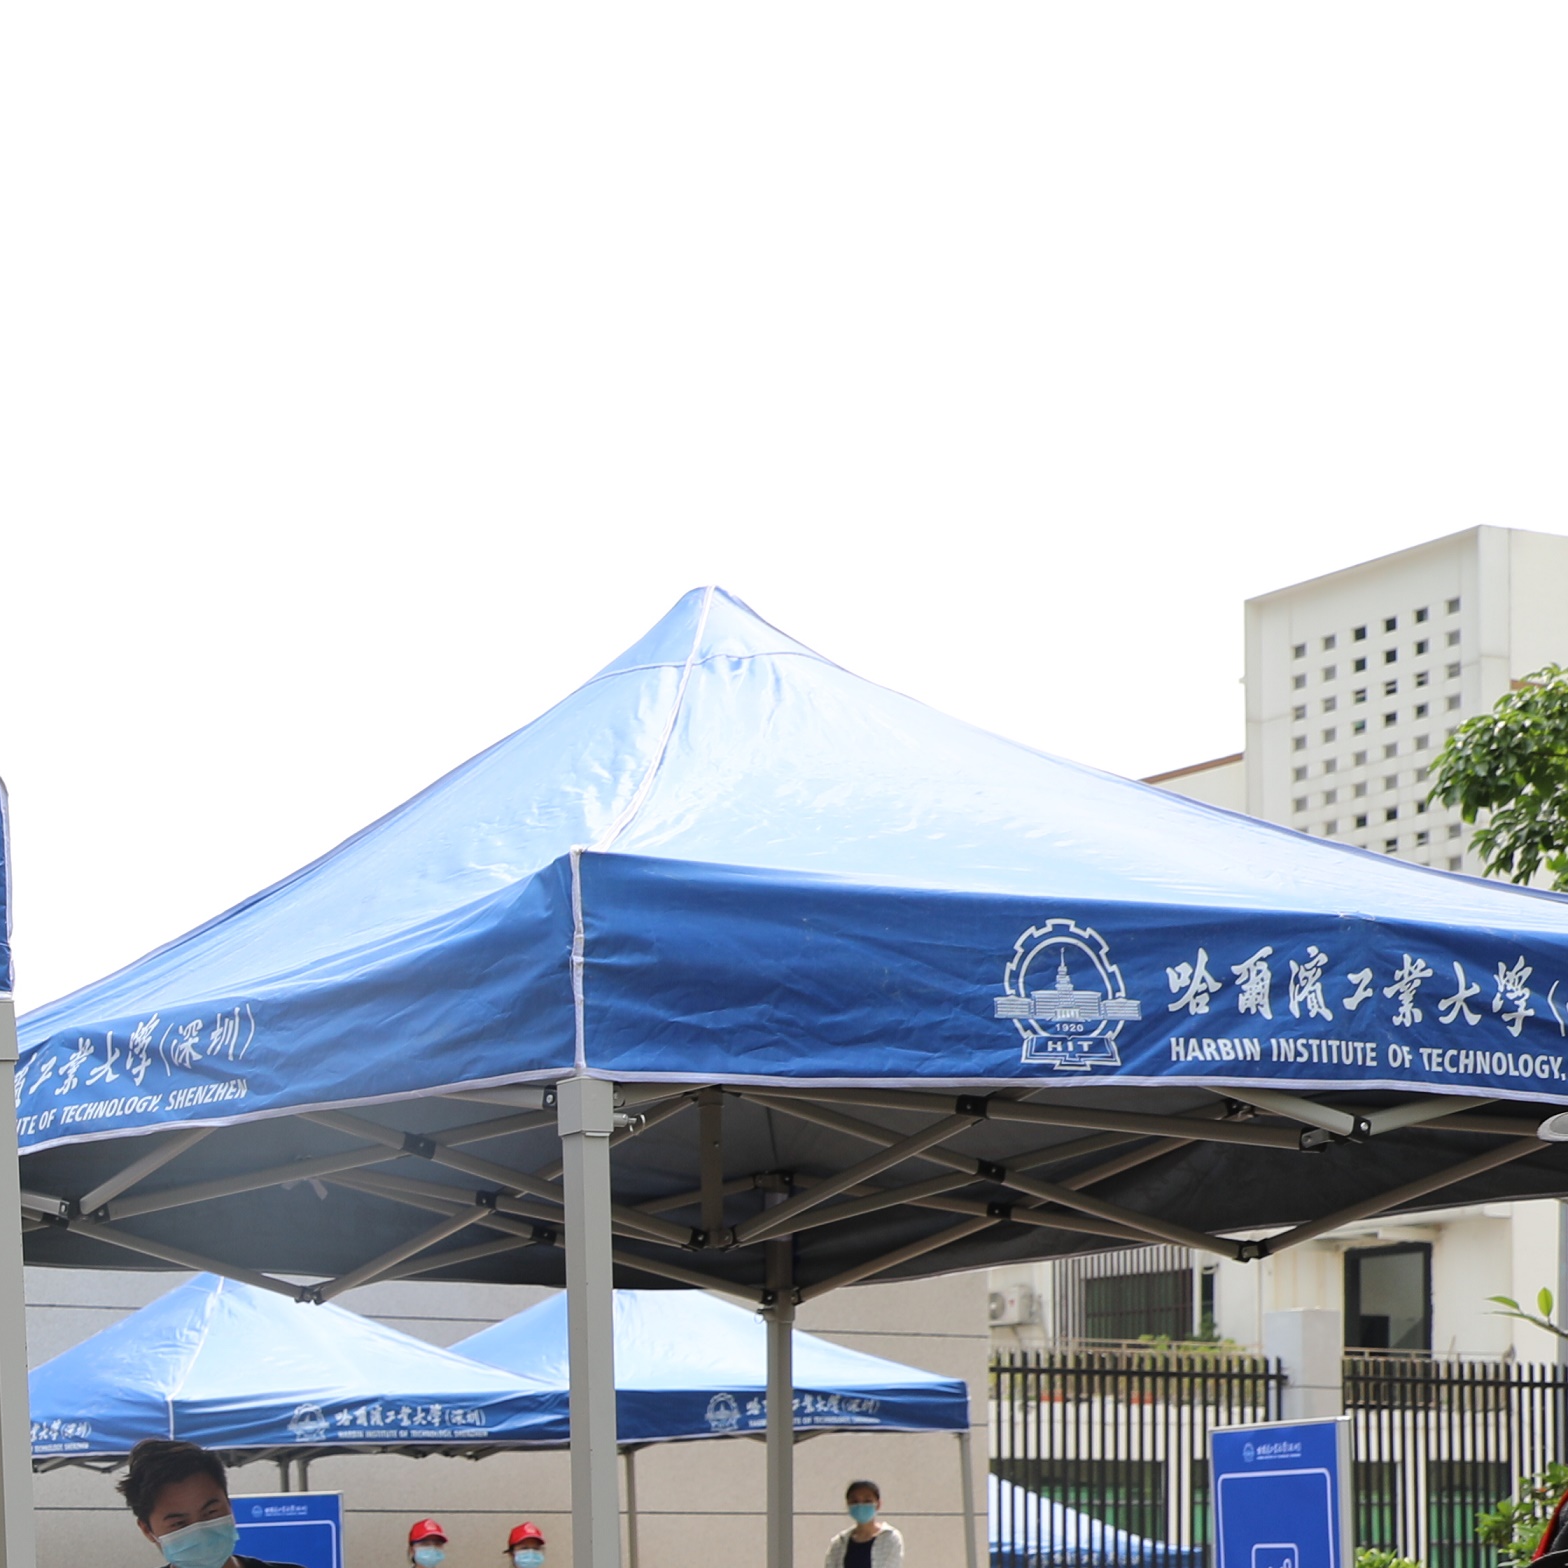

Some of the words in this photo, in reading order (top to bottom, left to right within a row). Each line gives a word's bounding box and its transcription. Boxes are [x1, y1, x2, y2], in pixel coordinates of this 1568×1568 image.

[1165, 945, 1568, 1038] 哈爾濱工業大學(
[1047, 1040, 1094, 1053] HIT
[1054, 1023, 1084, 1033] 1920
[1170, 1037, 1261, 1062] HARBIN
[1270, 1038, 1378, 1067] INSTITUTE
[1387, 1043, 1413, 1069] OF
[1418, 1047, 1567, 1081] TECHNOLOGY,
[38, 1109, 55, 1130] OF
[60, 1095, 161, 1126] TECHNOLOGY,
[165, 1079, 248, 1112] SHENZHEN
